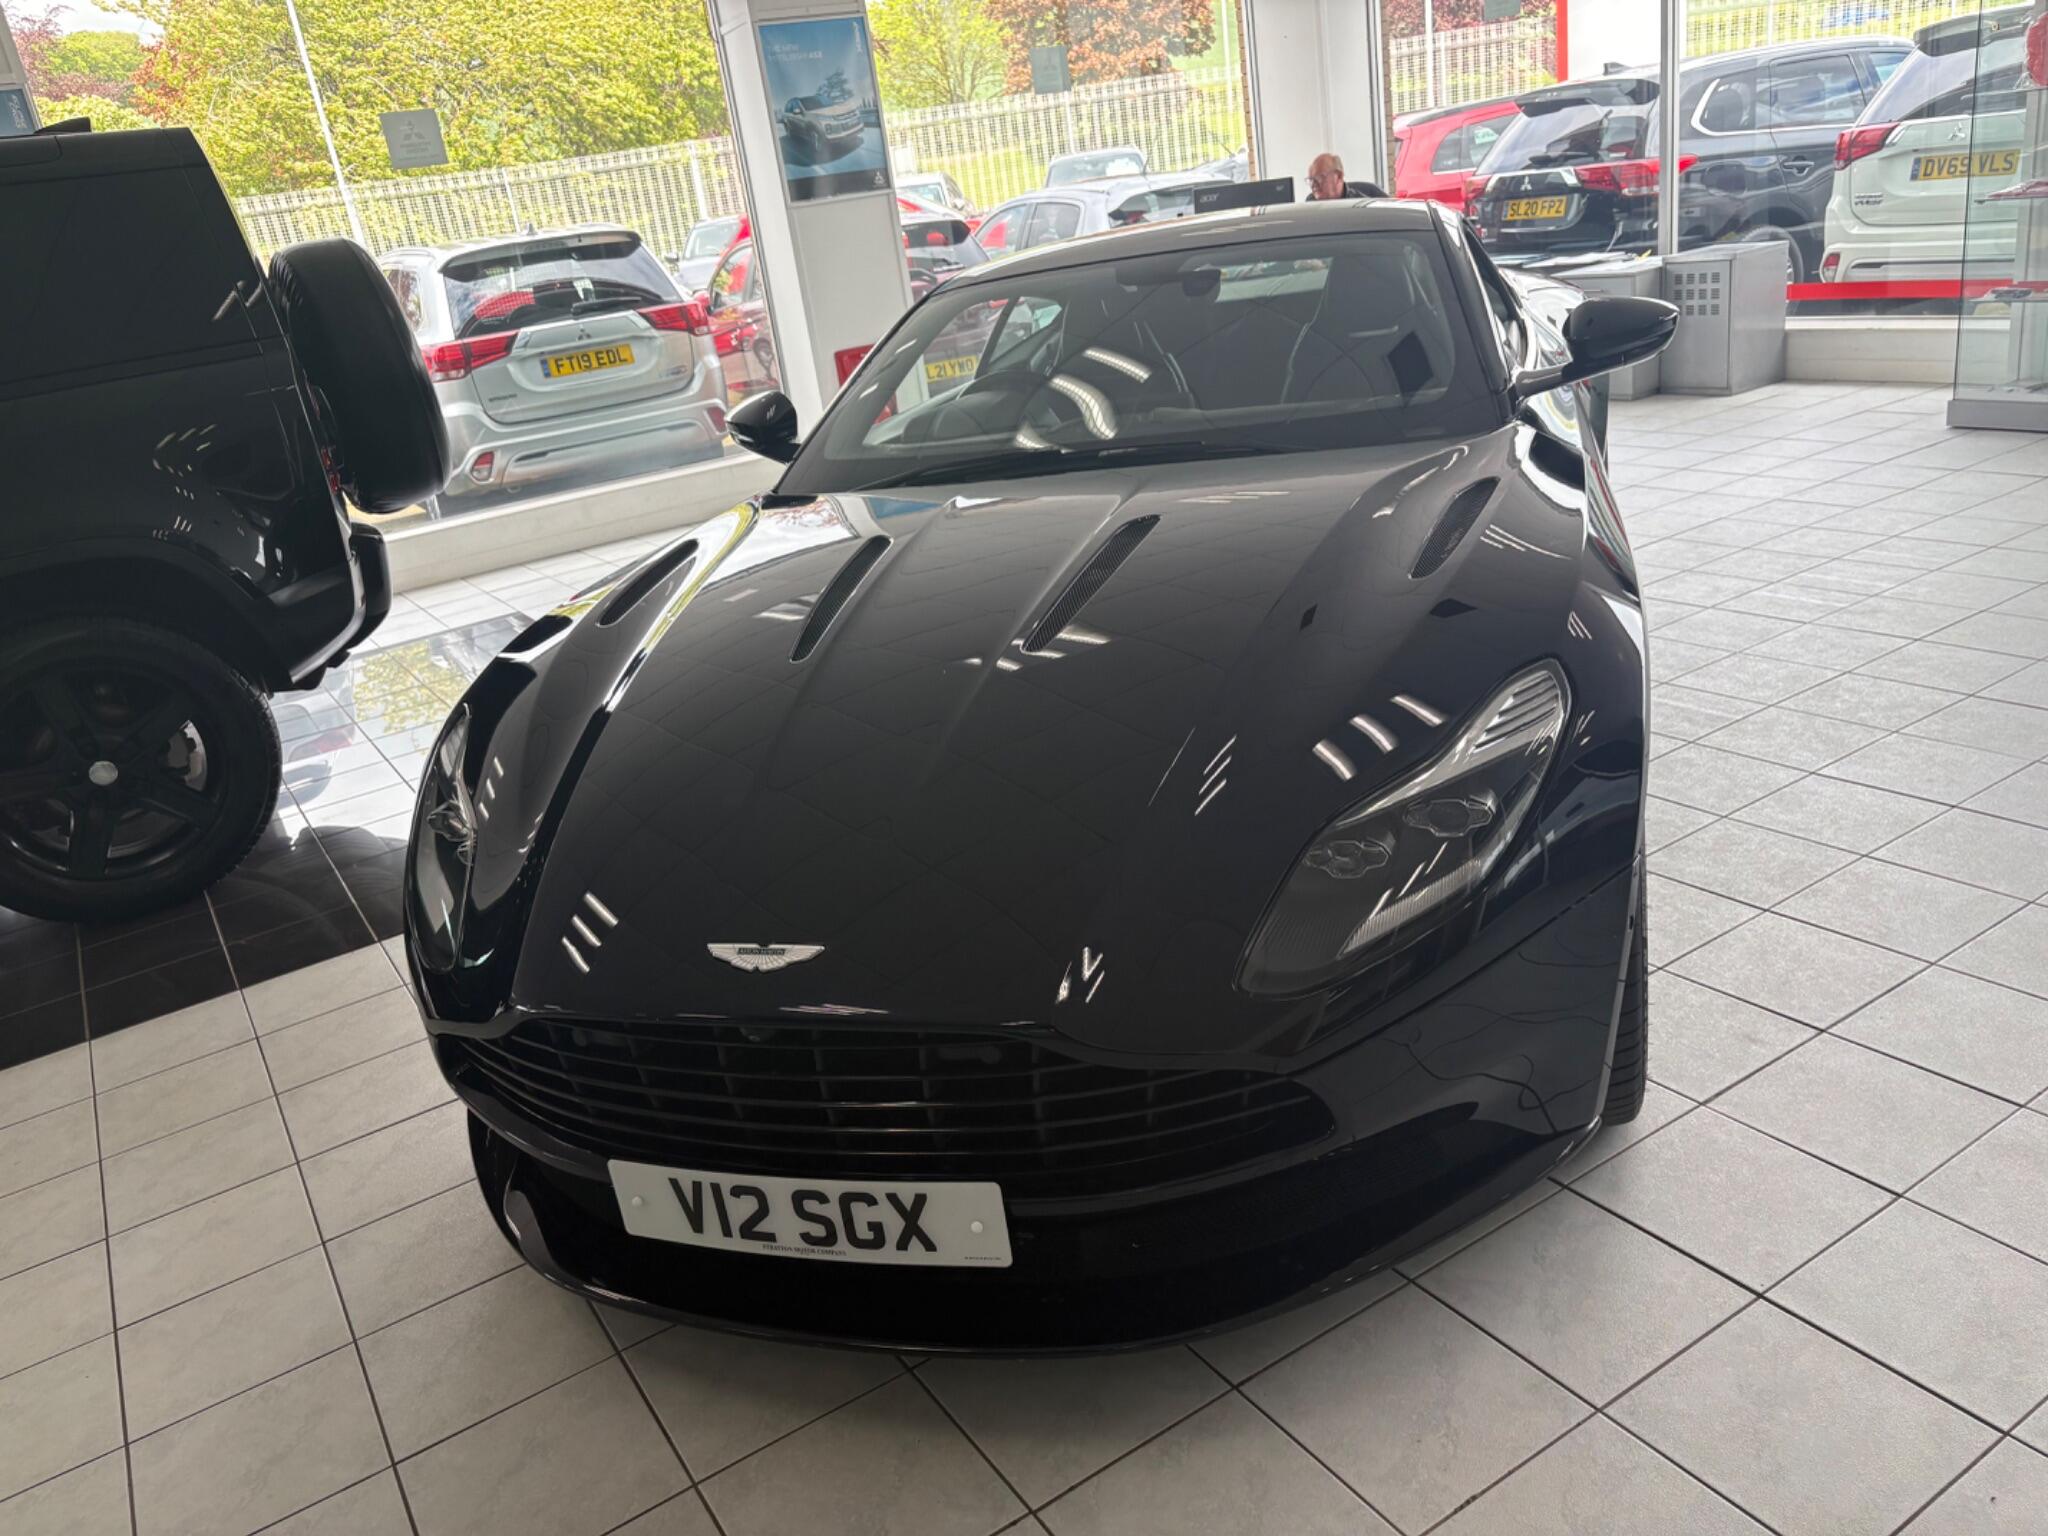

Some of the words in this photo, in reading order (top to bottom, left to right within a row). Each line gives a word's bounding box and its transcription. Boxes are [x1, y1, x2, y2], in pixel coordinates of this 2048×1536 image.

[1922, 157, 1969, 177] DV69
[1979, 153, 2015, 173] VLS
[1509, 201, 1539, 217] SL20
[1540, 199, 1564, 215] FPZ
[554, 353, 593, 374] FT19
[595, 347, 628, 368] EDL
[668, 1177, 777, 1243] V12
[791, 1189, 938, 1252] SGX
